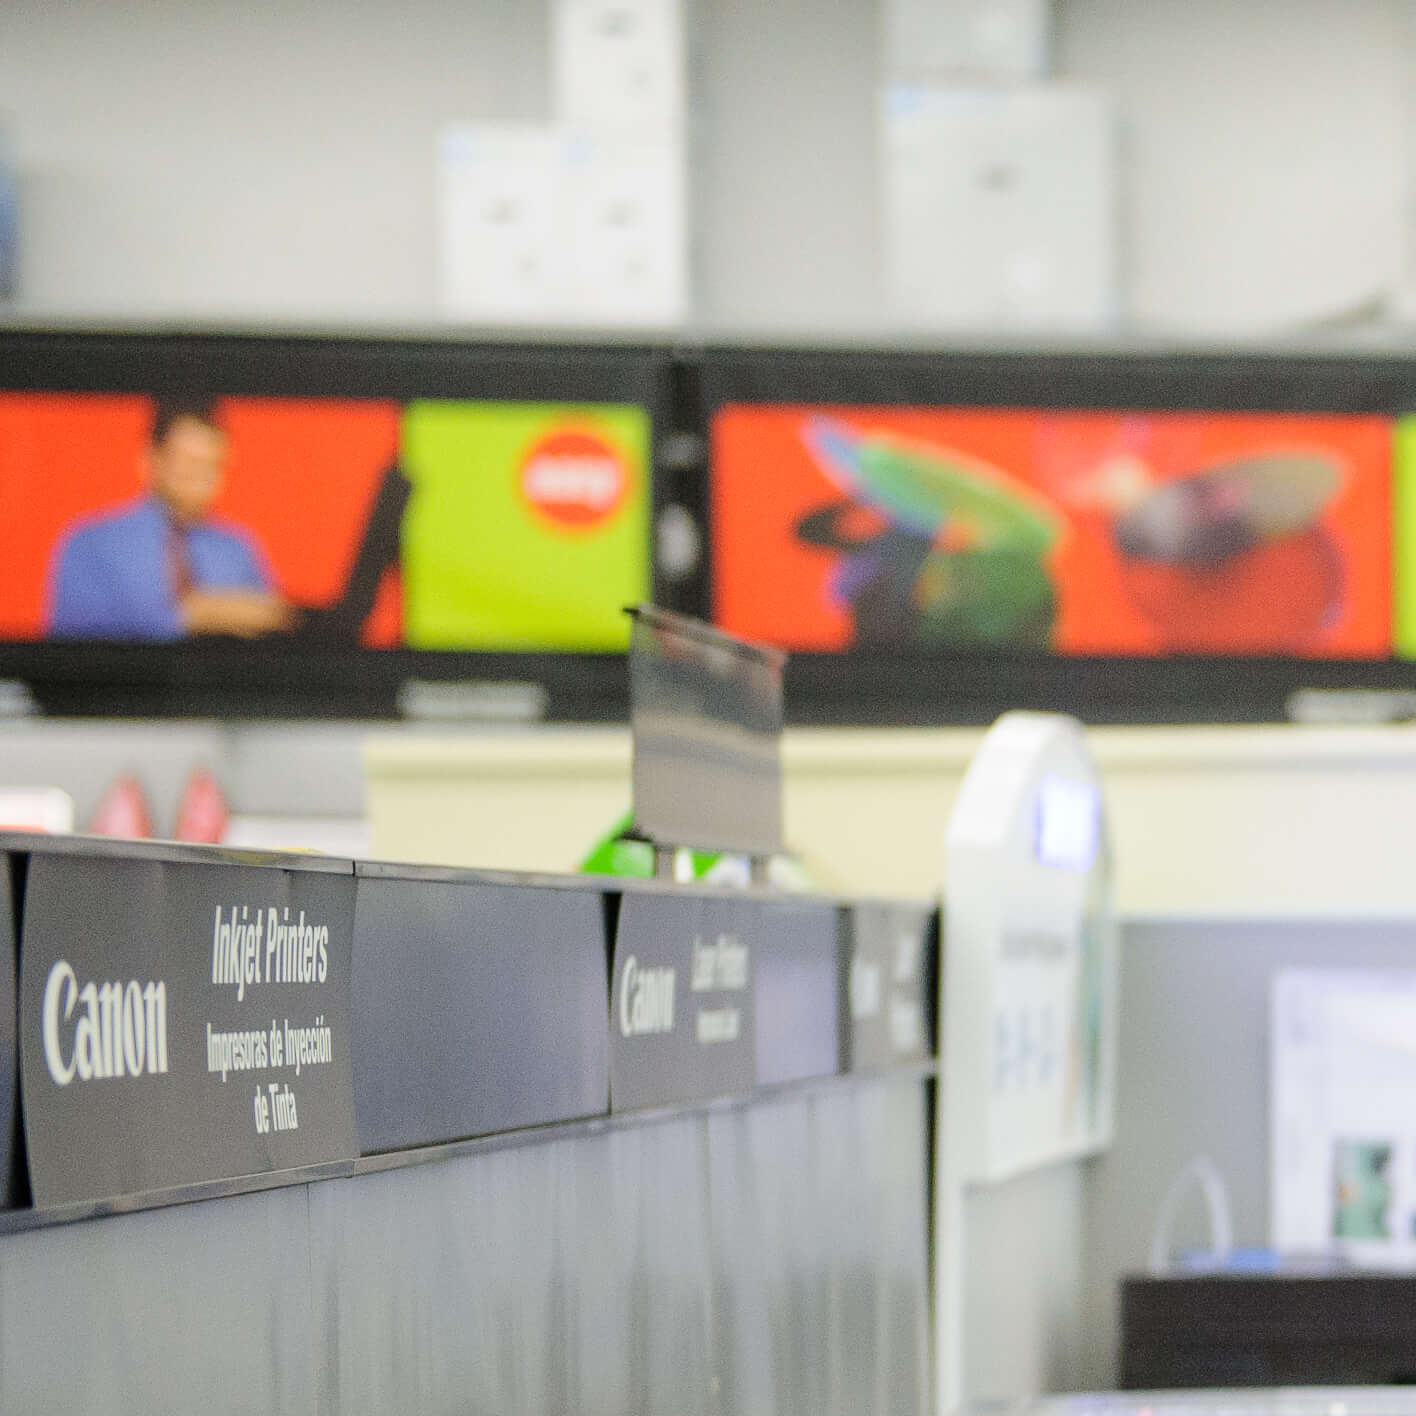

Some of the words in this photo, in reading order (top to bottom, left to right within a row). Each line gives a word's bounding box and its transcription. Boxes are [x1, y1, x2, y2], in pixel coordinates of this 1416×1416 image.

[212, 905, 263, 1001] Inkjet
[265, 907, 328, 983] Printers
[42, 960, 168, 1086] Canon
[207, 1022, 267, 1082] Impresoras
[269, 1019, 283, 1067] de
[284, 1015, 332, 1076] Inyección
[254, 1085, 269, 1133] de
[269, 1083, 298, 1131] Tinta
